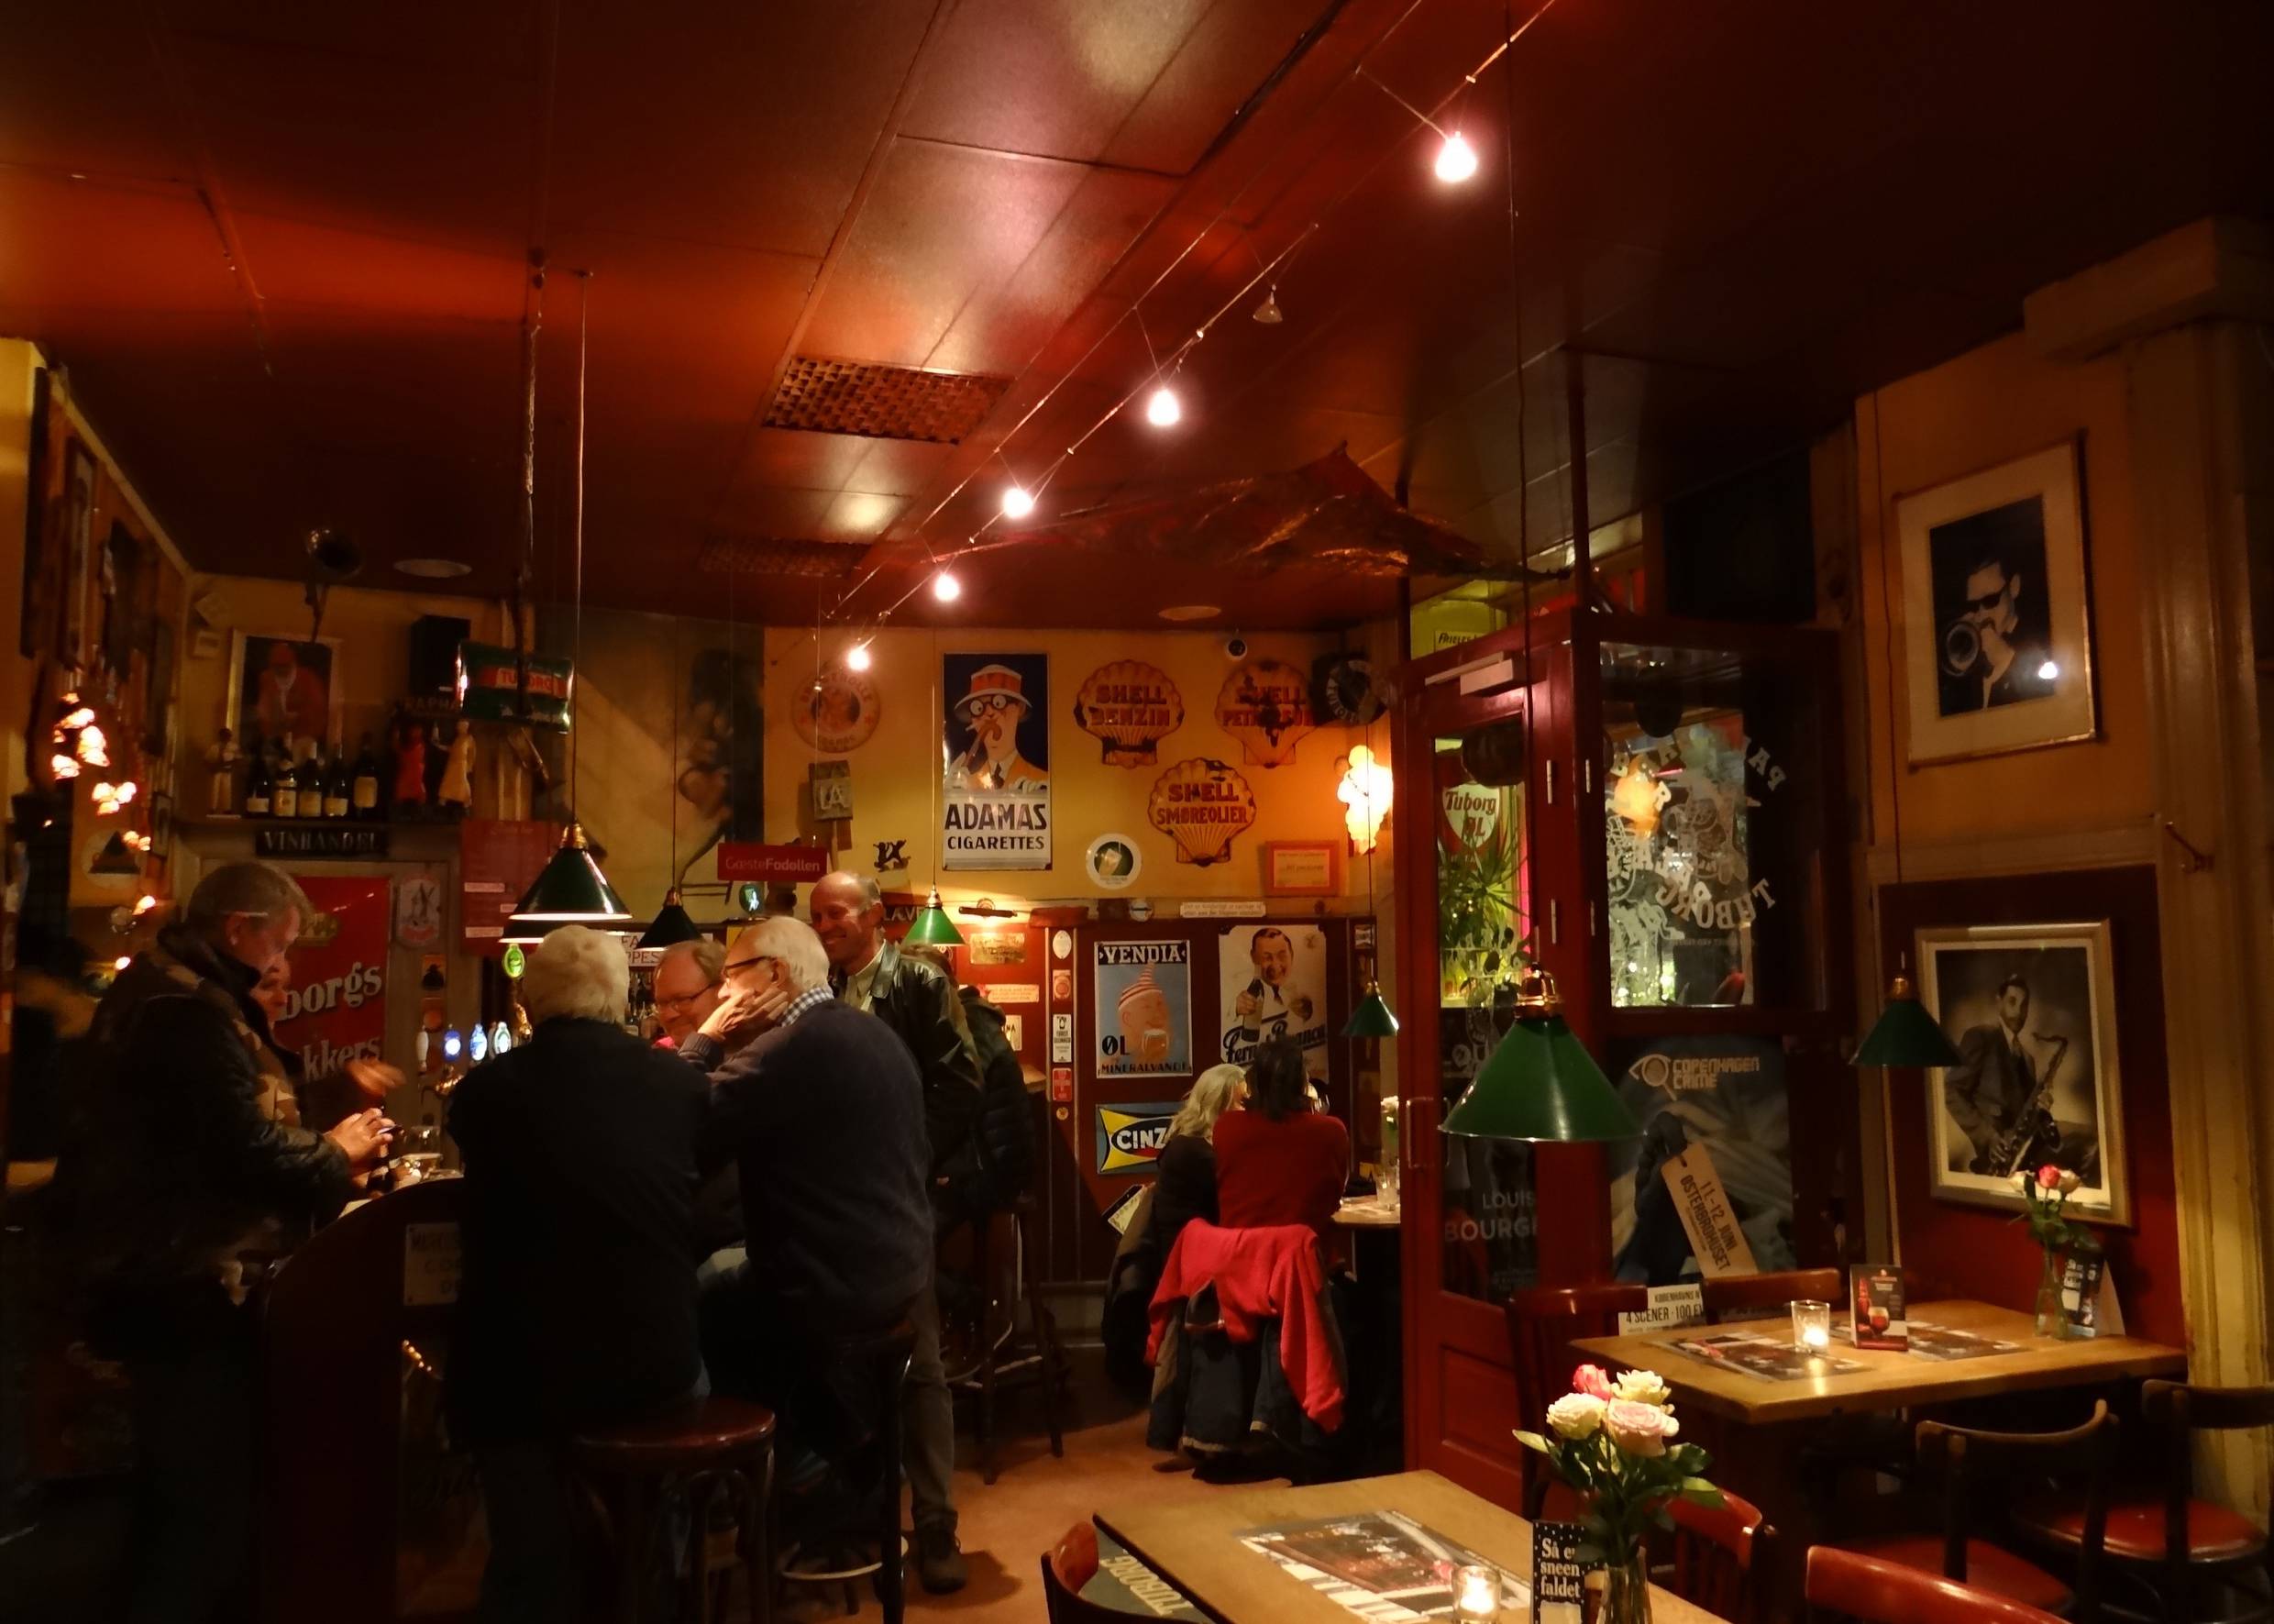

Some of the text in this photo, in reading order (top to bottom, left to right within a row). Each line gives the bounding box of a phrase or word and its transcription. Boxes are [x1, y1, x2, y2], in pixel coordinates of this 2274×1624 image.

[501, 668, 551, 690] TUORG
[1096, 685, 1167, 705] SHELL
[1167, 783, 1239, 802] SHELL
[1445, 791, 1496, 815] Tuborg
[944, 802, 1048, 831] ADAMAS
[946, 835, 1045, 851] CIGARETTES
[1102, 945, 1182, 964] VENDIA
[1101, 1034, 1130, 1055] ØL
[1673, 1056, 1761, 1073] COPENHAGEN
[1673, 1073, 1717, 1089] CRIME
[1116, 1127, 1168, 1150] CINZ
[1626, 1311, 1632, 1324] 4
[1634, 1306, 1670, 1323] SCENER
[1541, 1537, 1560, 1559] Så
[1540, 1562, 1581, 1577] sneen
[1098, 1554, 1195, 1617] TUBORG
[1540, 1574, 1582, 1598] faldet
